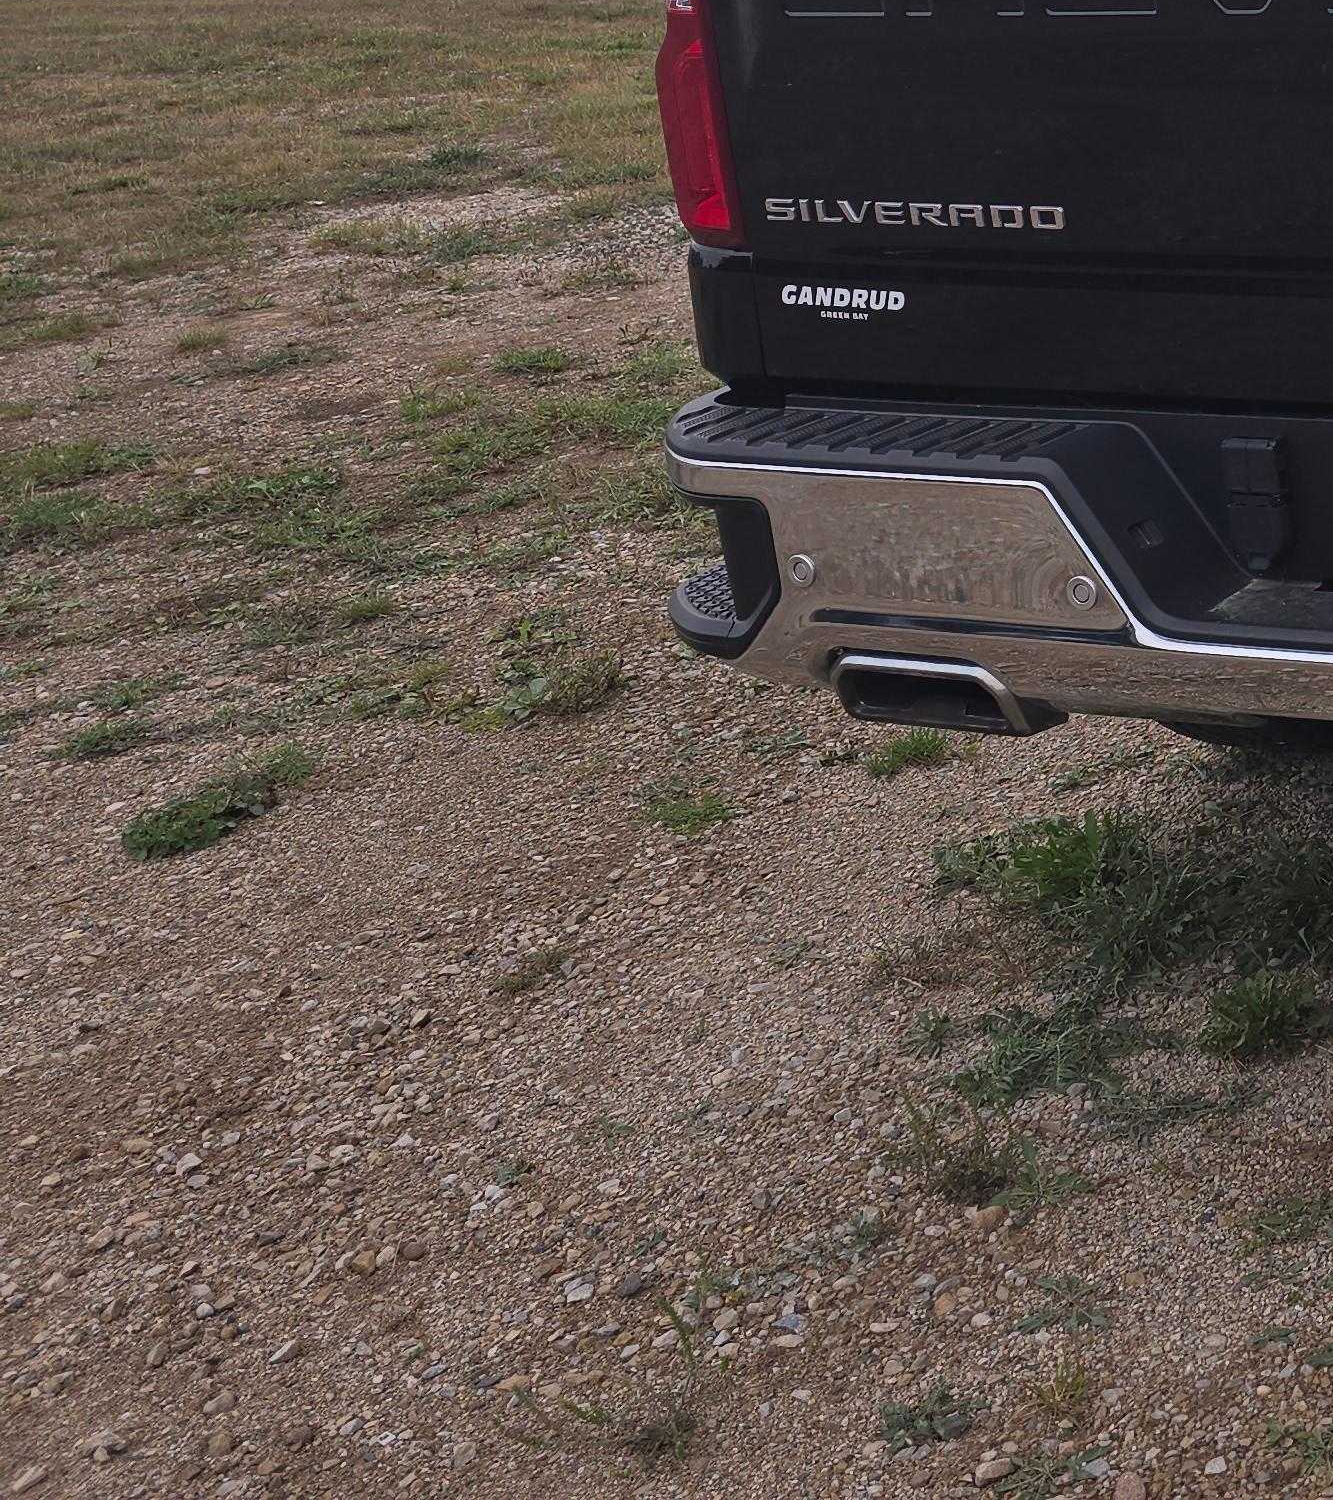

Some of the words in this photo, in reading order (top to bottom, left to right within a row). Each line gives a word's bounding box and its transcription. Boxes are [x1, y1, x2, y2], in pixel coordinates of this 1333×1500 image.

[764, 197, 1066, 231] SILVERADO
[780, 283, 906, 312] GANDRUD
[821, 310, 850, 319] GREEN
[853, 312, 869, 320] BAY
